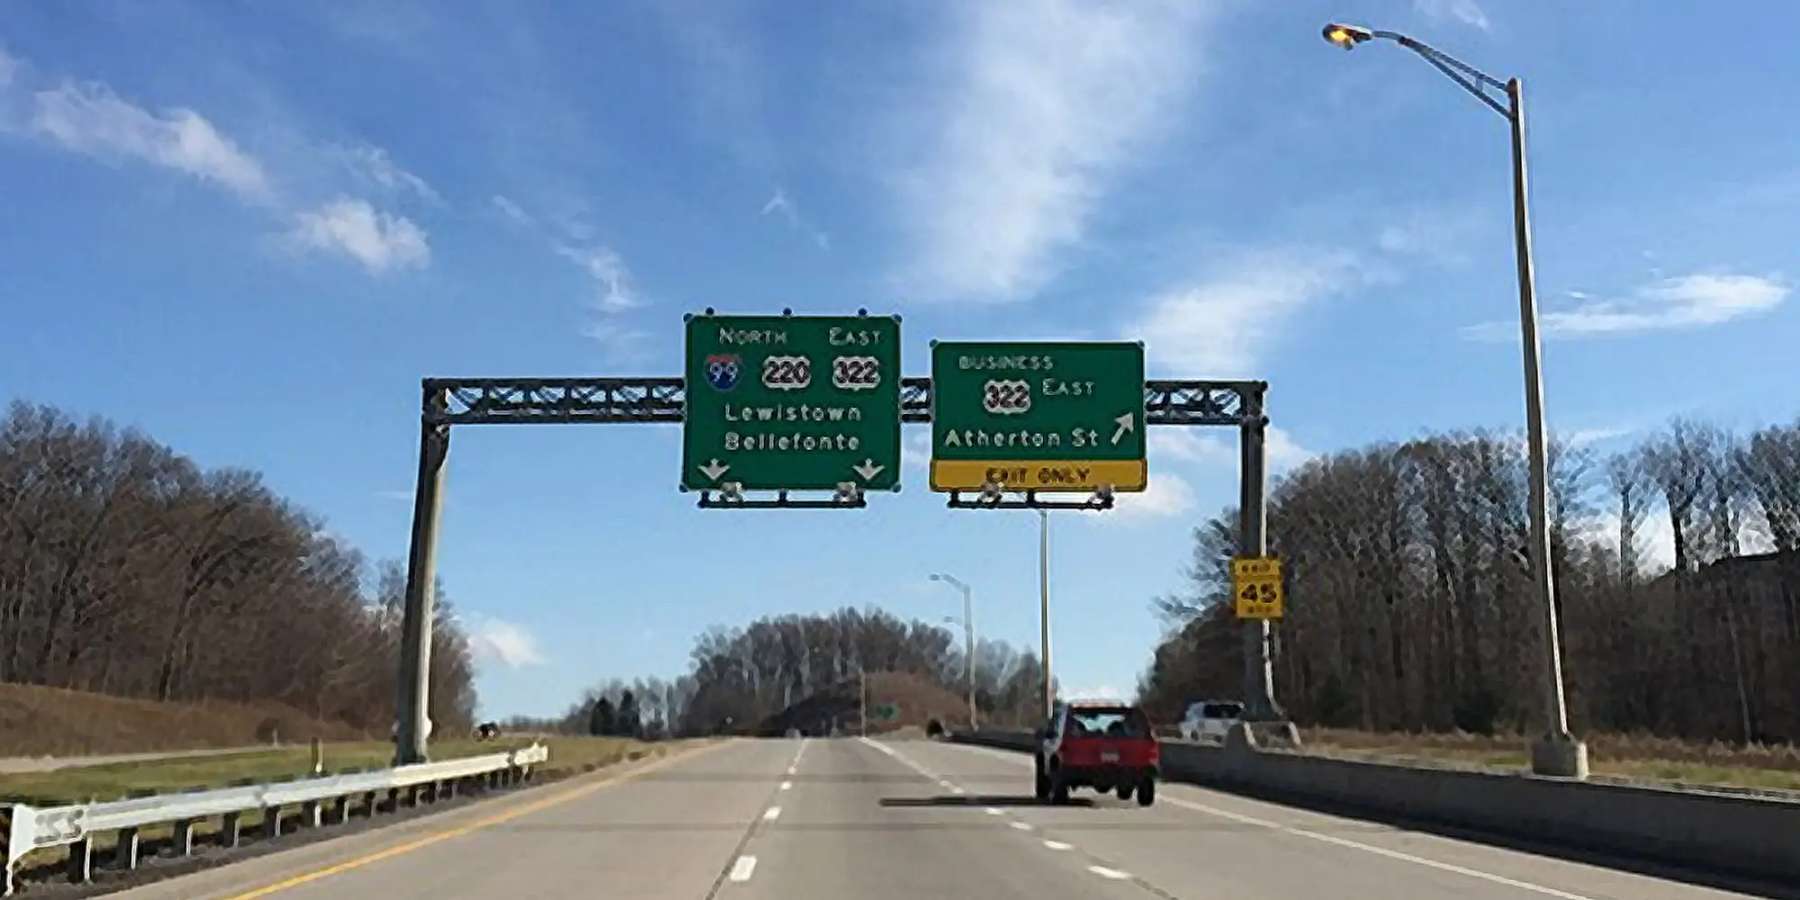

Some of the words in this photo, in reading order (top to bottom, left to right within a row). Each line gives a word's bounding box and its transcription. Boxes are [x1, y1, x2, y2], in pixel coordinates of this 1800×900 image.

[709, 361, 738, 383] 99
[765, 360, 809, 384] 220
[836, 360, 878, 384] 322
[958, 355, 1054, 370] BUSINESS
[986, 384, 1029, 409] 322
[725, 403, 861, 422] Lewistown
[725, 431, 860, 450] Bellefonte
[944, 429, 1060, 447] Atherton
[1071, 427, 1099, 447] St
[986, 467, 1028, 483] EXIT
[1038, 467, 1090, 484] ONLY
[1241, 583, 1277, 604] 45
